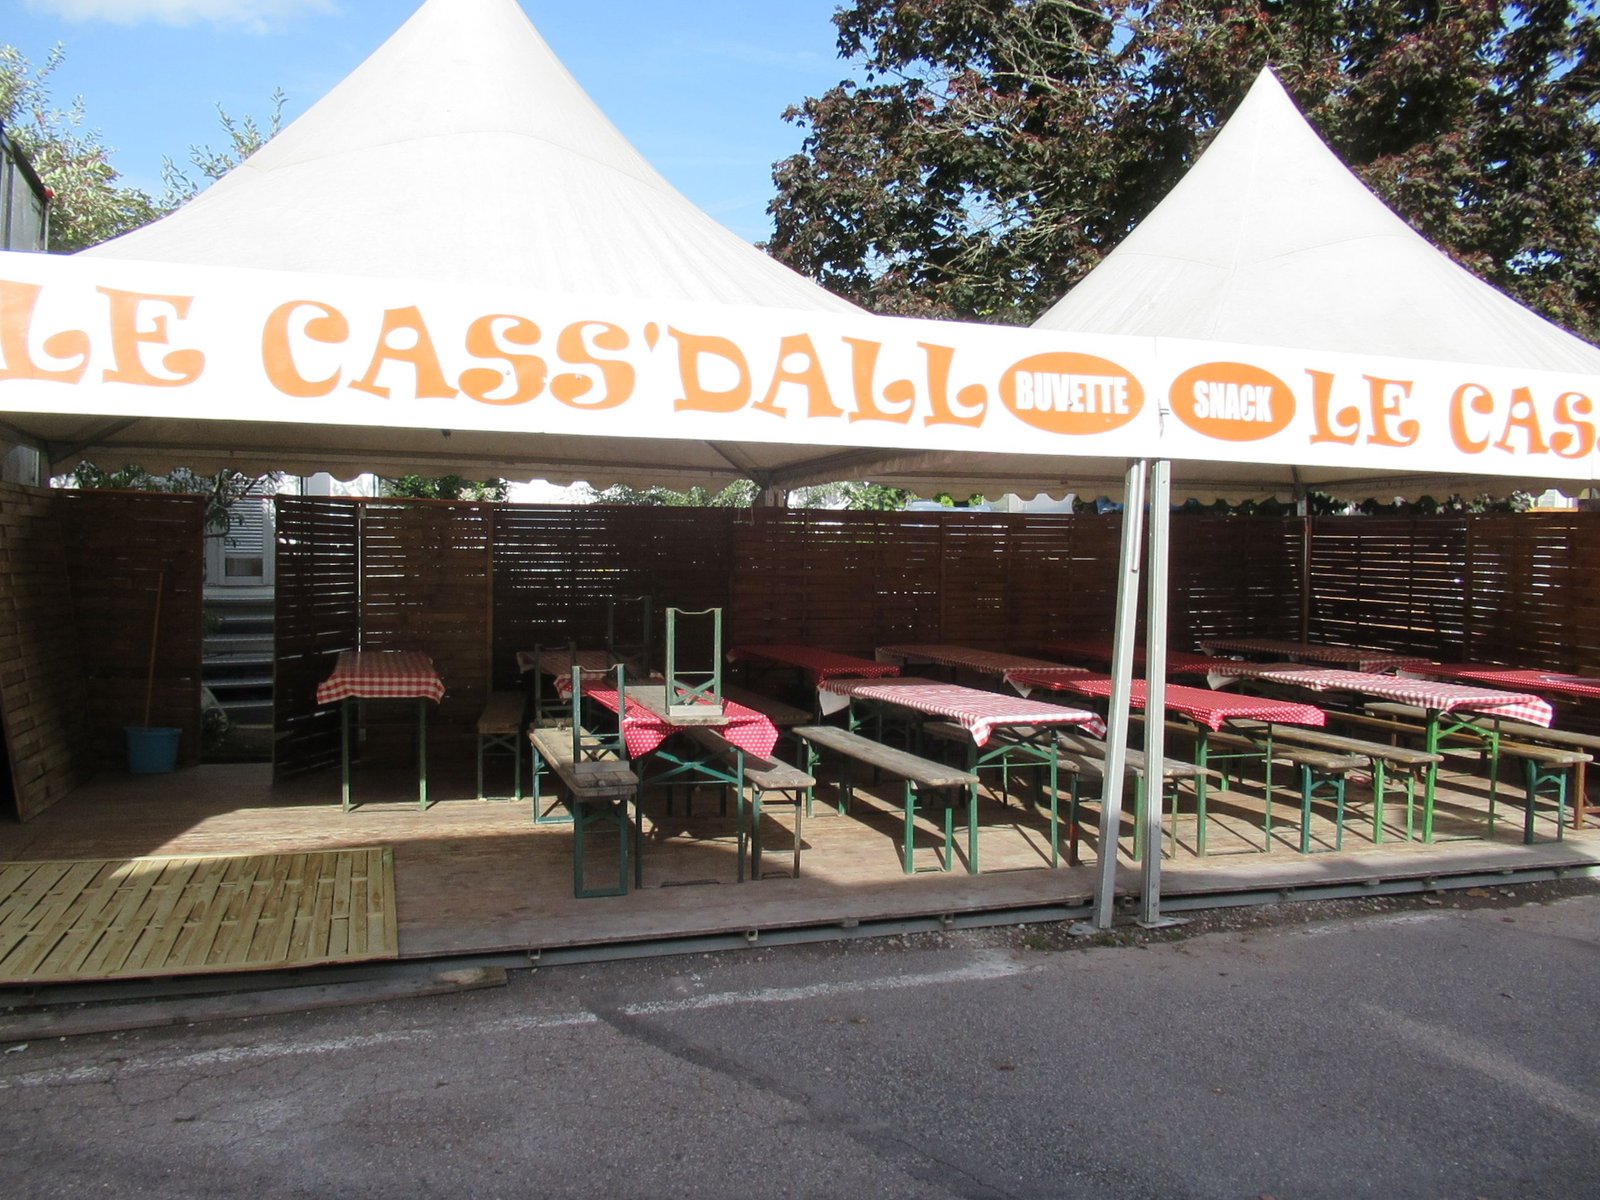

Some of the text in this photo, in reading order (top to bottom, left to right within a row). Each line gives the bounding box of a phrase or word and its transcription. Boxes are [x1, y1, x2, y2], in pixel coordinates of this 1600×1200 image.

[0, 279, 990, 429] LE CASS'DALL
[1014, 370, 1130, 415] BUVETTE
[1193, 379, 1274, 423] SNACK
[1304, 368, 1600, 460] LE CAS
